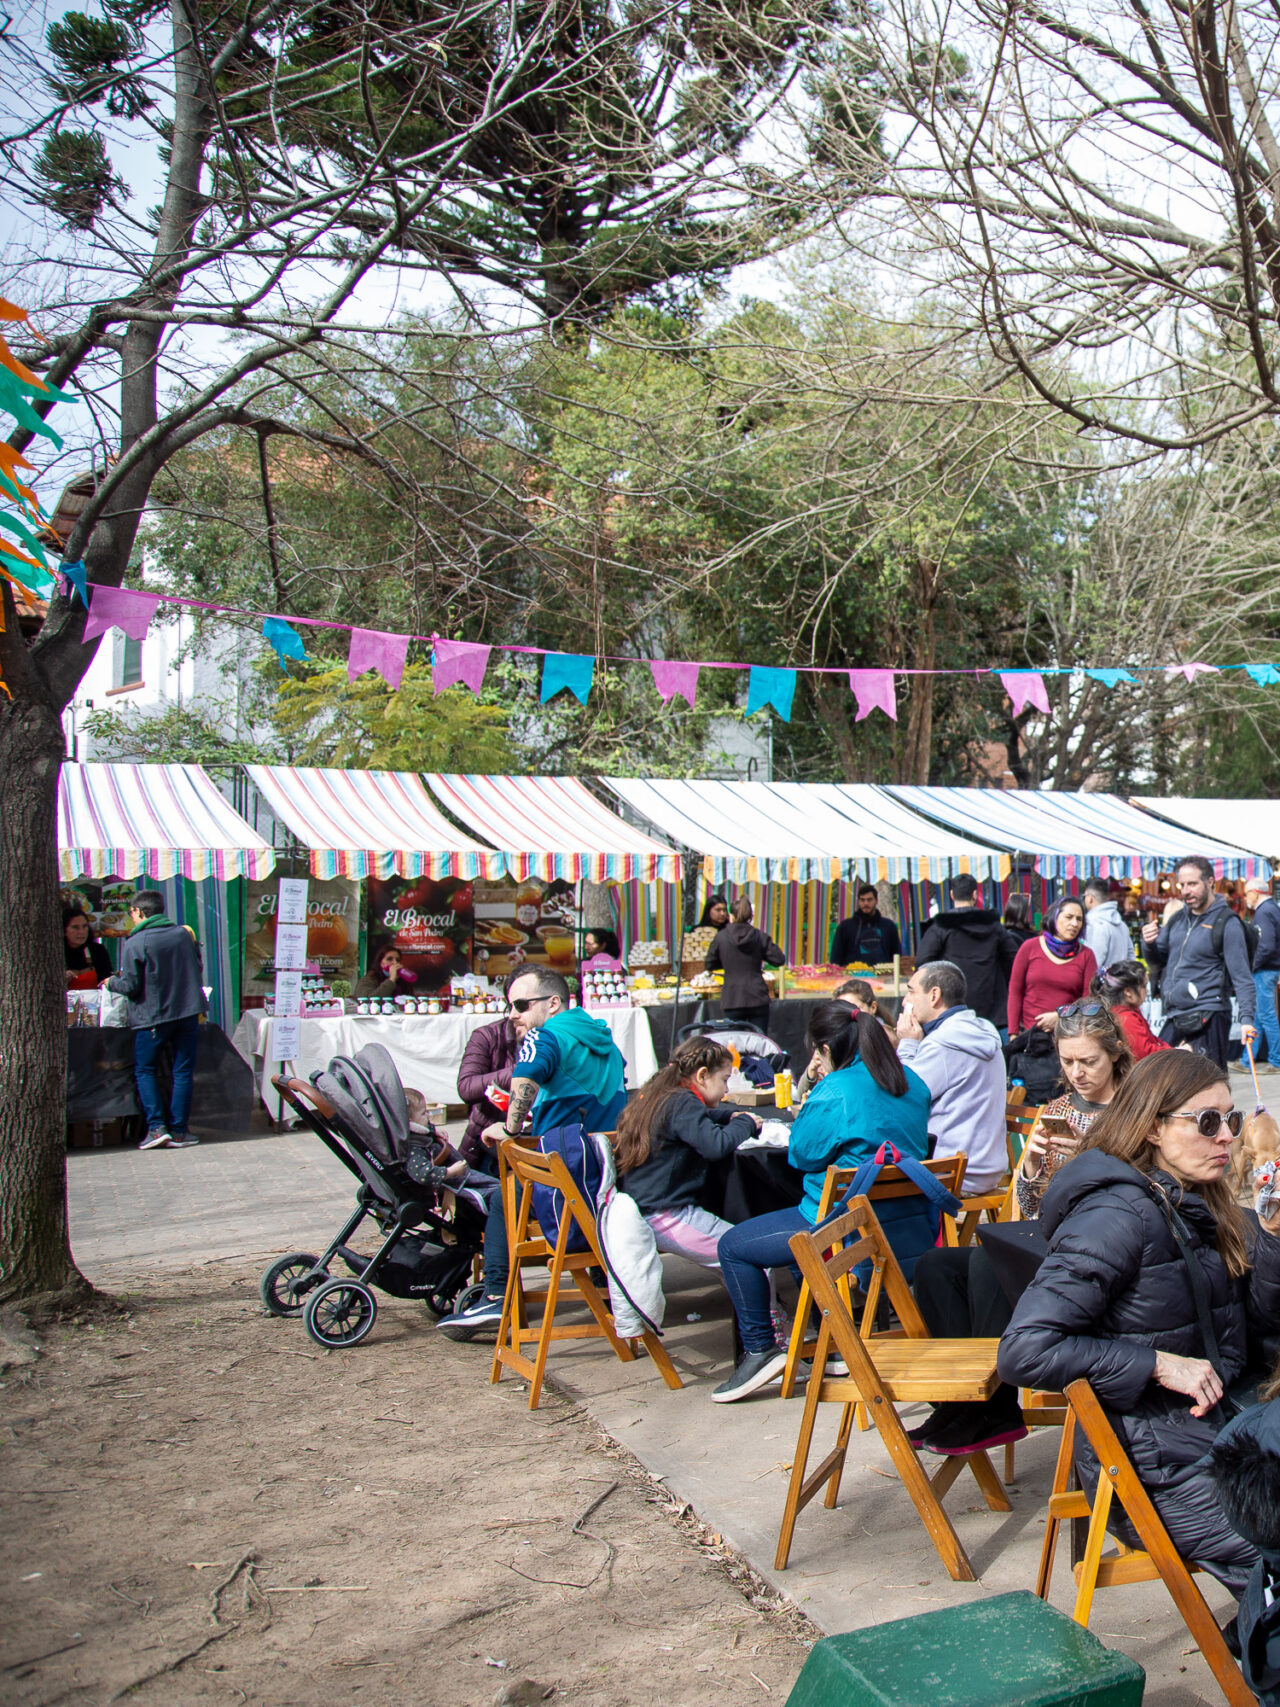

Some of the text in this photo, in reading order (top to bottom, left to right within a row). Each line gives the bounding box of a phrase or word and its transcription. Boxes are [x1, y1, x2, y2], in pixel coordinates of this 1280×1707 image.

[257, 894, 278, 915] El
[383, 906, 456, 928] El Brocal
[364, 1150, 385, 1171] BEVERLY
